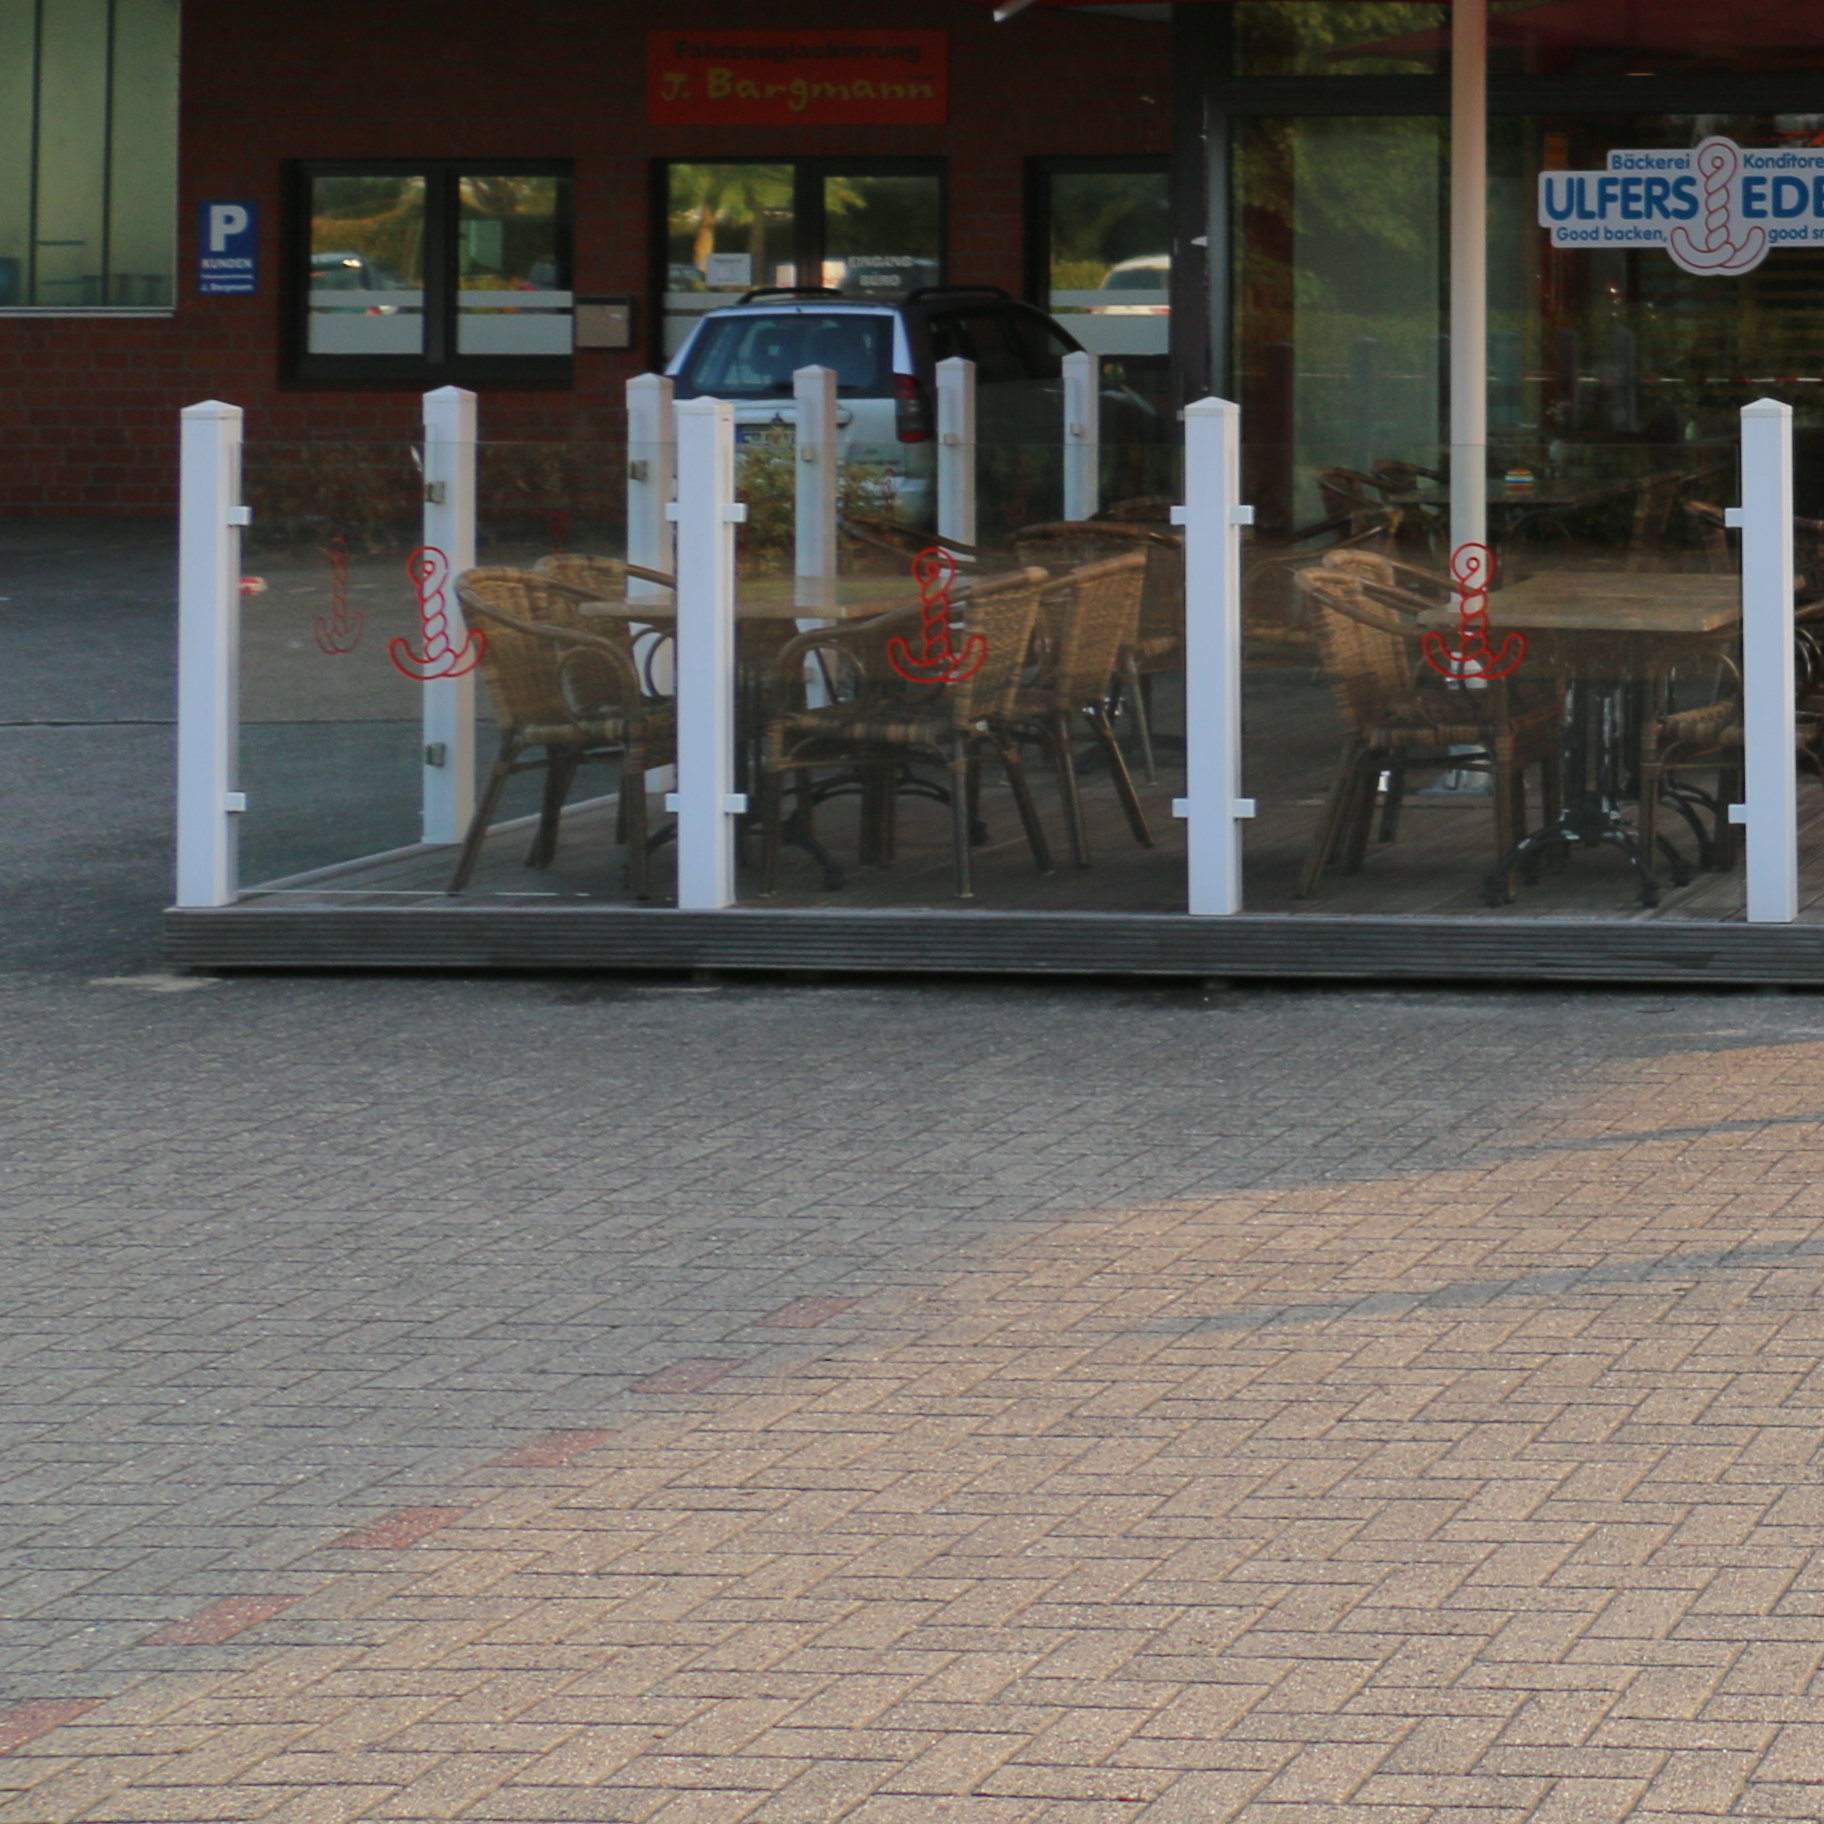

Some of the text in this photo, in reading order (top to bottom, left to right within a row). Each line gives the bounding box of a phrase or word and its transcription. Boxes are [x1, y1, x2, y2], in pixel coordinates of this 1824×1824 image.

[674, 41, 922, 64] Fahrzeuglackierung
[660, 67, 934, 112] J. Bargmann
[1612, 154, 1690, 170] Bäckerei
[1545, 176, 1699, 221] ULFERS
[210, 205, 248, 251] P
[1556, 227, 1599, 241] Good
[1604, 227, 1667, 243] backen,
[1768, 226, 1808, 243] good
[201, 259, 252, 269] KUNDEN
[848, 255, 913, 267] EINGANG
[859, 272, 900, 286] BÜRO
